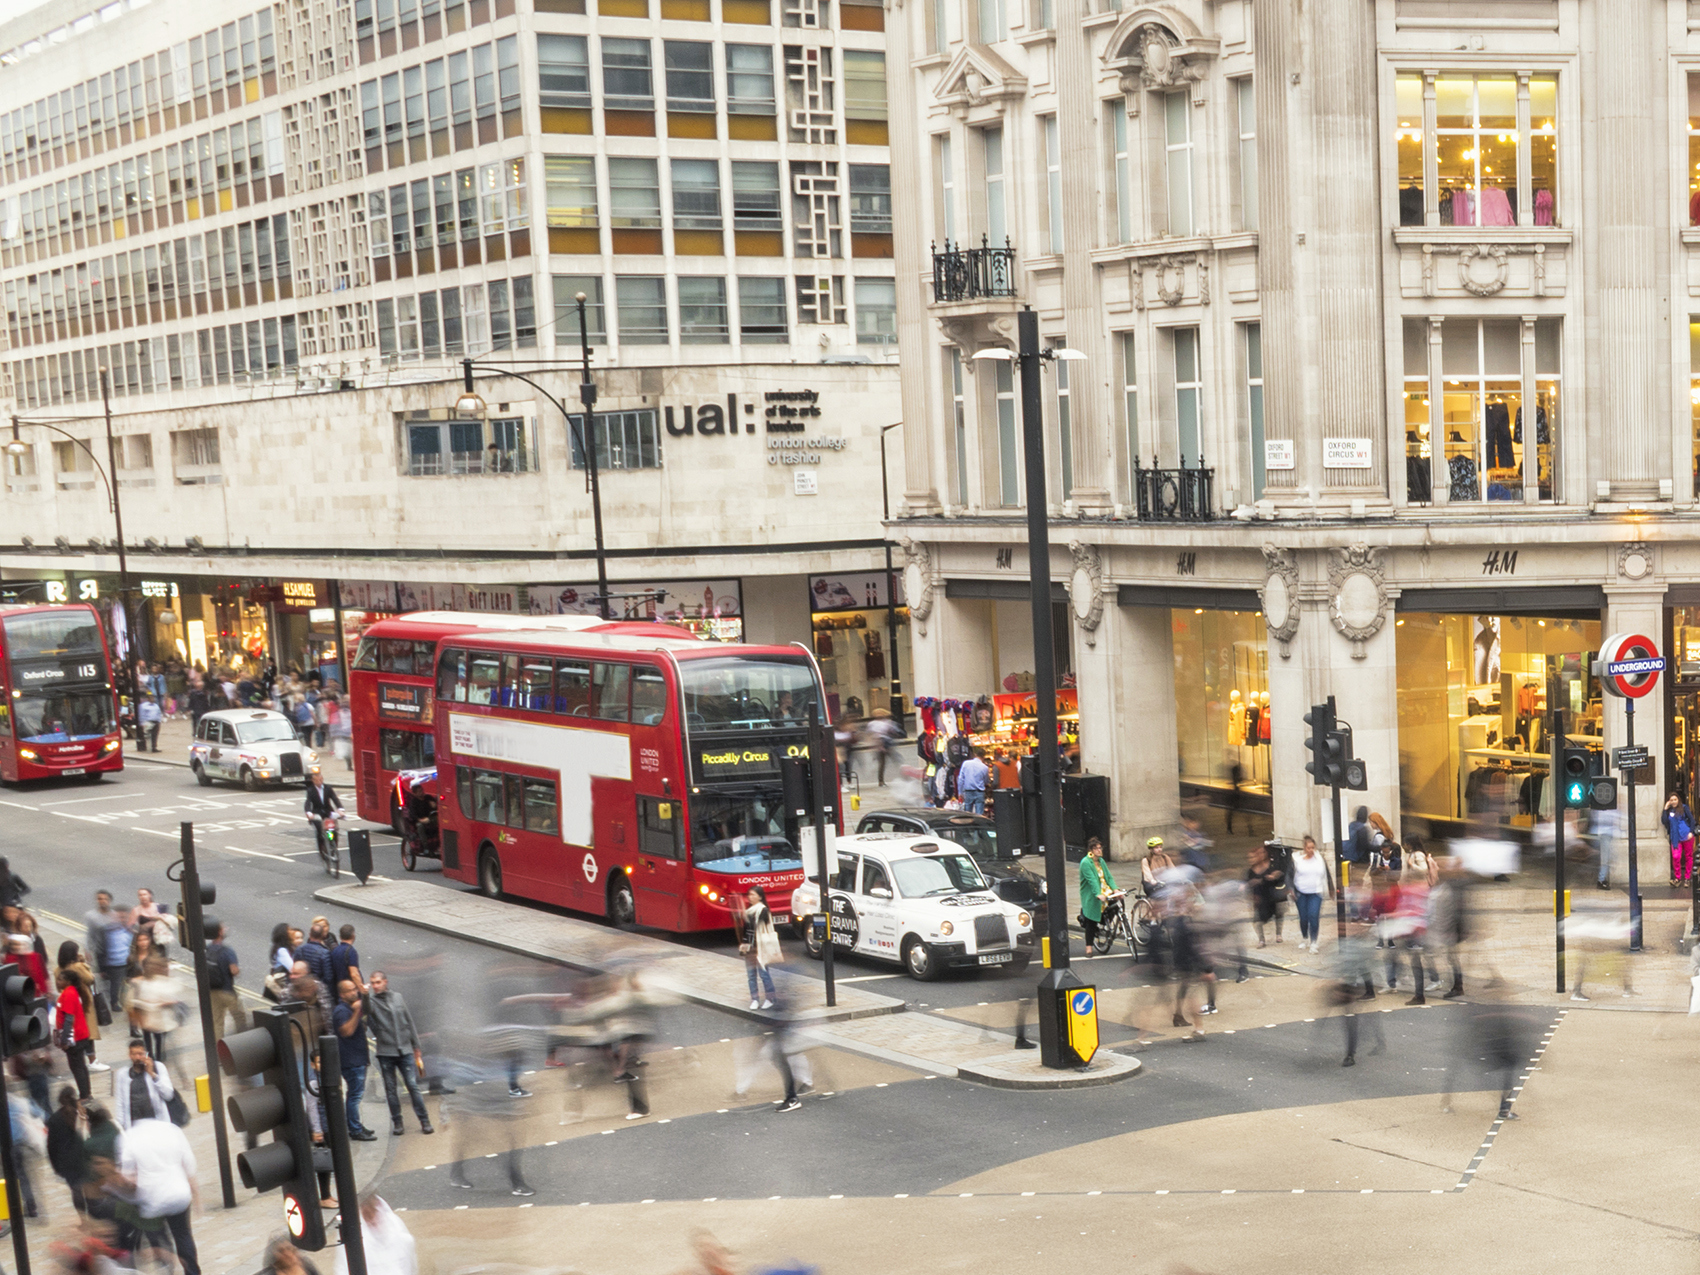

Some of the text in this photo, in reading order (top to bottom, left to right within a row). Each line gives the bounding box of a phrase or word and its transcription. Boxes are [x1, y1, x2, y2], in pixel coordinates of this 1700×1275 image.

[764, 389, 819, 404] university
[664, 393, 755, 436] ual:
[765, 405, 821, 417] of the arts
[766, 421, 805, 433] london
[767, 437, 847, 452] london college
[1328, 442, 1356, 450] OXFORD
[768, 451, 822, 464] of fashion
[996, 548, 1013, 570] H&M
[1176, 552, 1196, 576] H&M
[1482, 550, 1518, 575] H&M
[78, 664, 96, 677] 113
[1610, 661, 1663, 673] UNDERGROUND
[24, 671, 45, 679] Oxford
[640, 748, 659, 758] LONDON
[702, 752, 769, 765] Piccadilly Circus
[640, 757, 659, 767] UNITED
[171, 816, 293, 835] KEEP
[738, 873, 805, 884] LONDON UNITED
[832, 900, 847, 914] THE
[830, 916, 858, 931] GRAVIA
